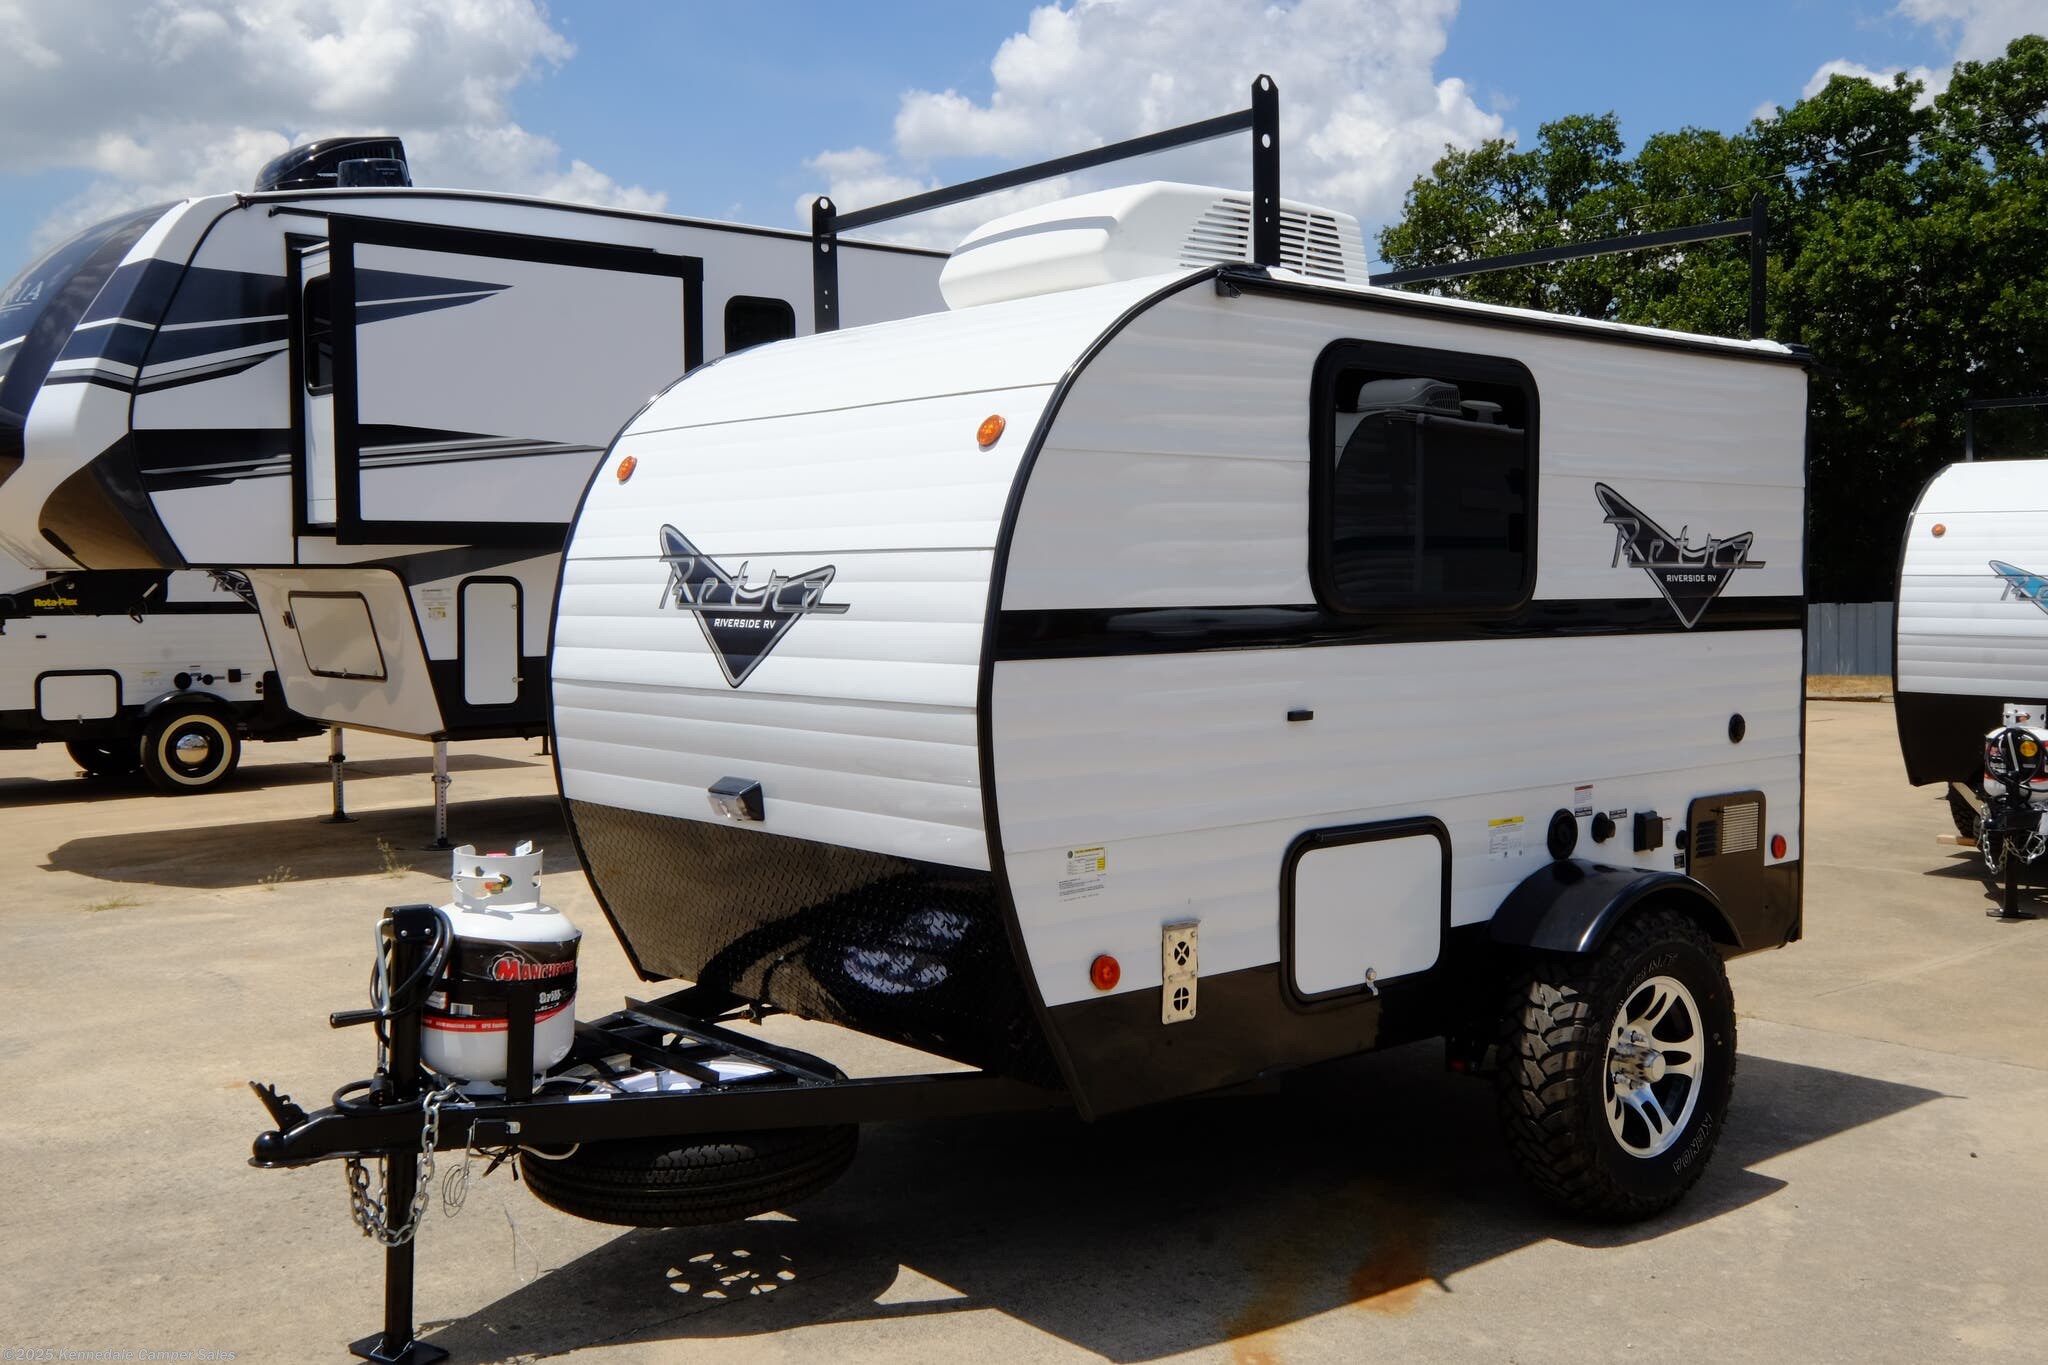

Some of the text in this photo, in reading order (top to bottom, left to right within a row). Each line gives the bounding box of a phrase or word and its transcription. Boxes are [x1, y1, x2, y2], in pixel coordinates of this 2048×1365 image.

[1603, 516, 1766, 569] Retro
[658, 554, 851, 614] Retro
[1666, 574, 1717, 583] RIVERSIDE RV
[713, 618, 777, 630] RIVERSIDE RV
[1671, 1113, 1714, 1177] KENDA
